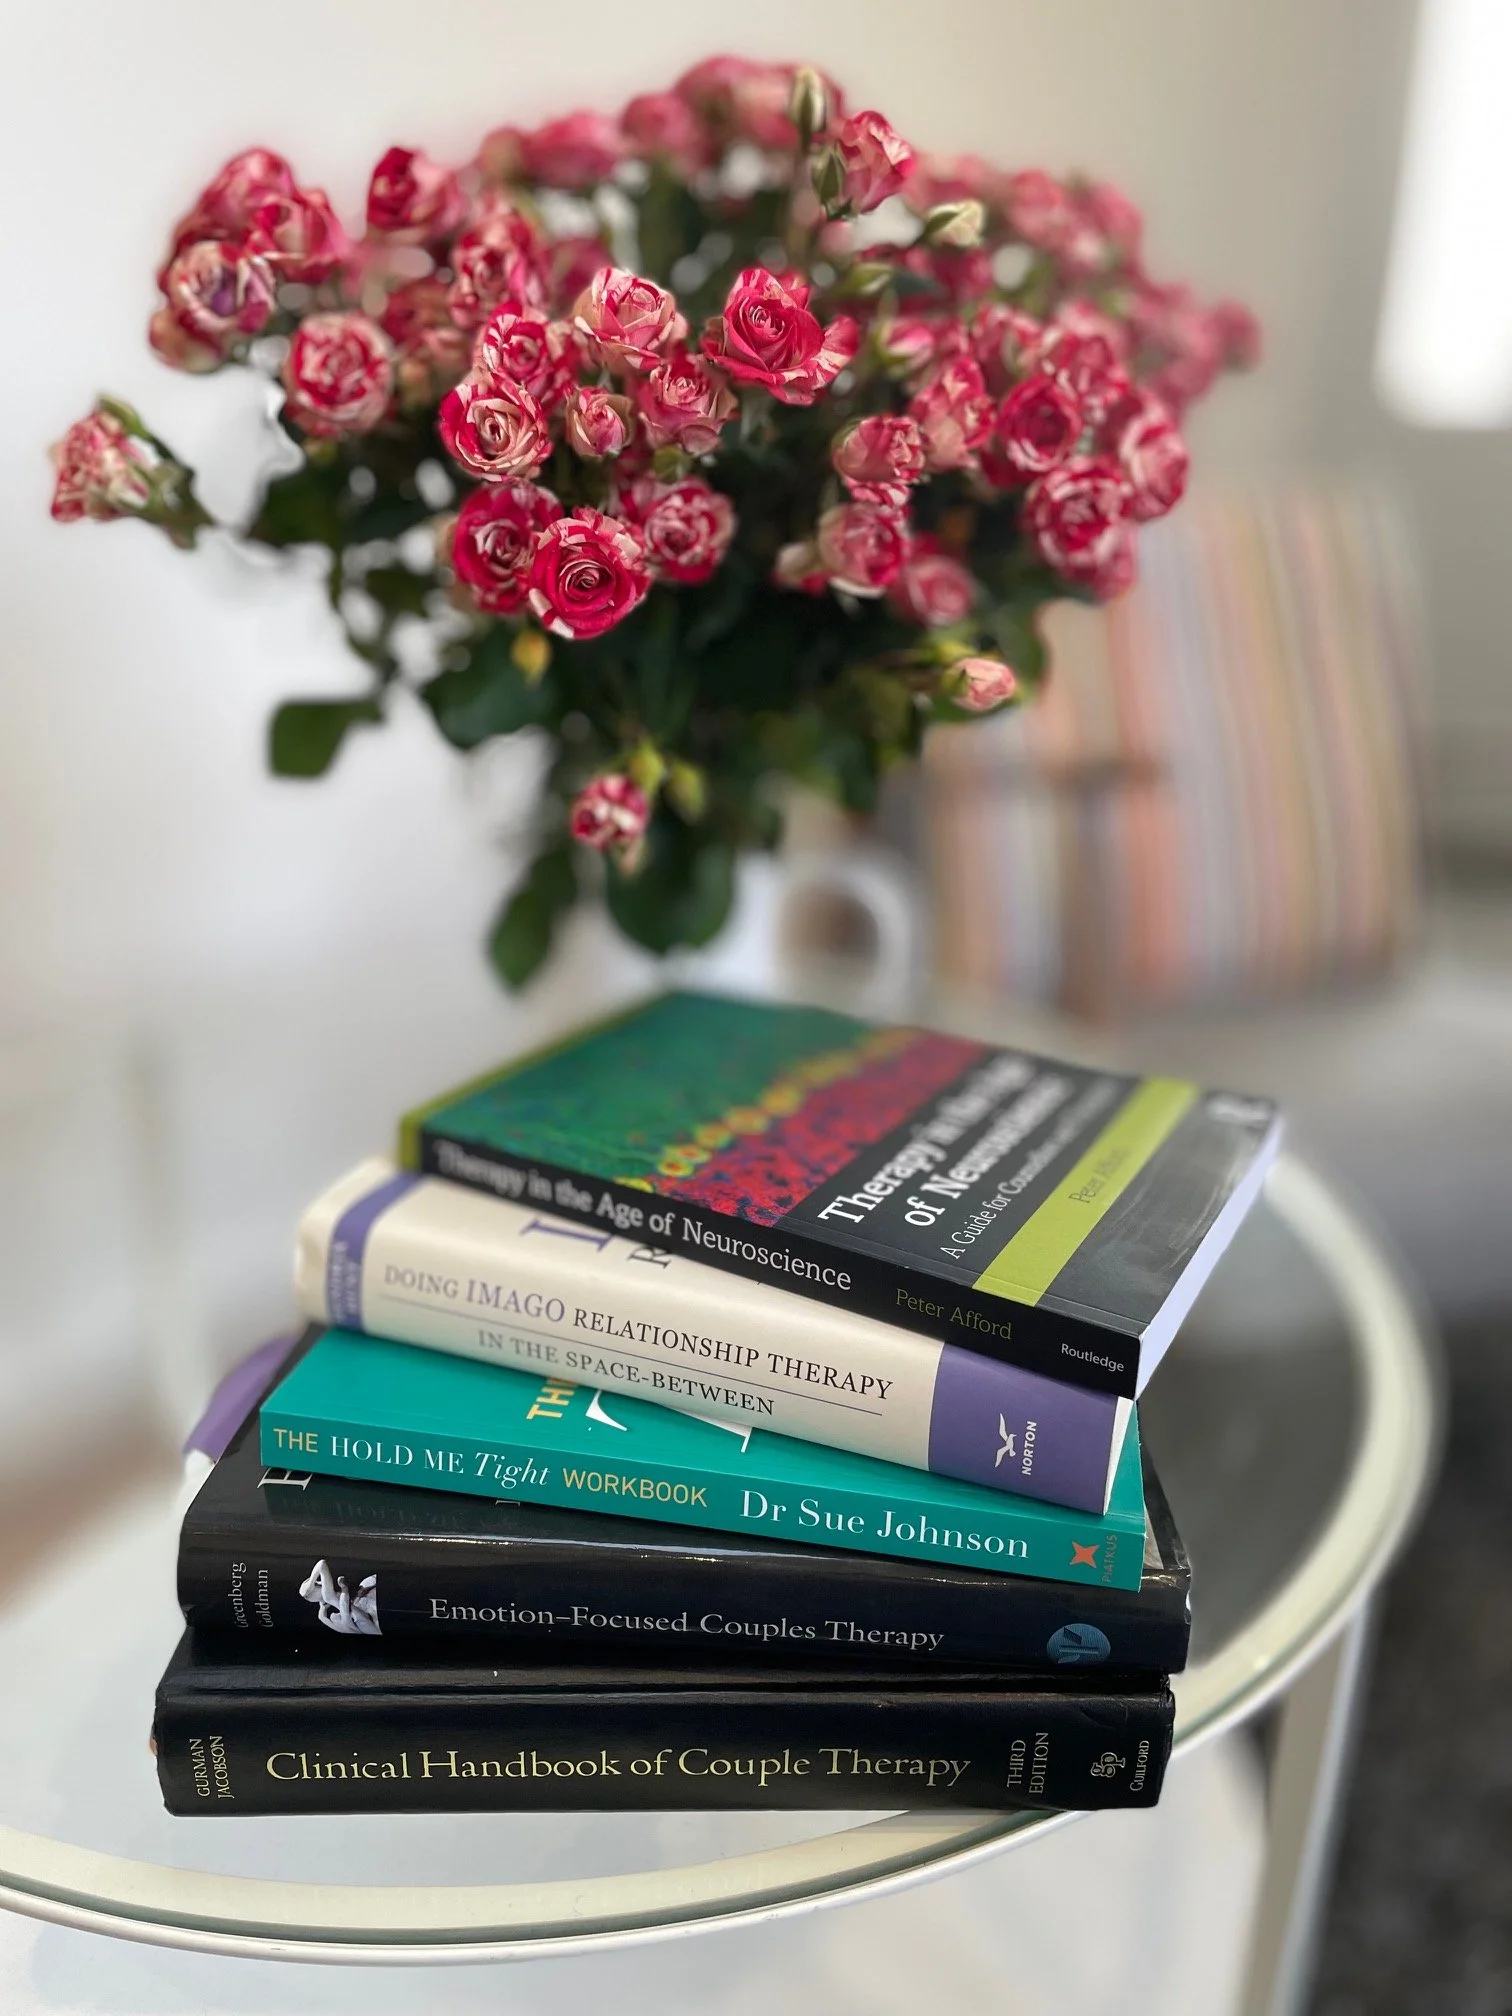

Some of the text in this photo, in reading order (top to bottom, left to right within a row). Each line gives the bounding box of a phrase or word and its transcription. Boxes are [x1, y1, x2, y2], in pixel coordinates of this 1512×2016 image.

[817, 1138, 948, 1224] Therapy
[982, 1193, 1012, 1214] for
[555, 1178, 593, 1213] the
[596, 1191, 644, 1230] Age
[649, 1212, 676, 1236] of
[682, 1216, 851, 1291] Neuroscience
[904, 1196, 946, 1226] of
[951, 1209, 997, 1244] Guide
[939, 1245, 965, 1259] A
[384, 1264, 459, 1300] DOING
[466, 1278, 566, 1323] IMAGO
[573, 1308, 760, 1368] RELATIONSHIP
[768, 1352, 894, 1400] THERAPY
[896, 1288, 1013, 1340] Peter Afford
[478, 1329, 775, 1416] IN THE SPACE-BETWEEN
[1061, 1342, 1125, 1373] Routledge
[273, 1428, 708, 1508] THE HOLD ME Tight WORKBOOK
[1022, 1421, 1037, 1475] NORTON
[739, 1490, 1029, 1560] Dr Sue Johnson
[1101, 1534, 1118, 1583] PIATKUS
[228, 1562, 249, 1628] Greenberg
[254, 1568, 274, 1628] Goldman
[428, 1598, 945, 1651] Emotion-Focused Couples Therapy
[189, 1738, 211, 1798] GURMAN
[209, 1735, 235, 1799] JACOBSON
[266, 1748, 971, 1787] Clinical Handbook of Couple Therapy
[1006, 1739, 1026, 1788] THIRD
[1028, 1732, 1049, 1794] EDITION
